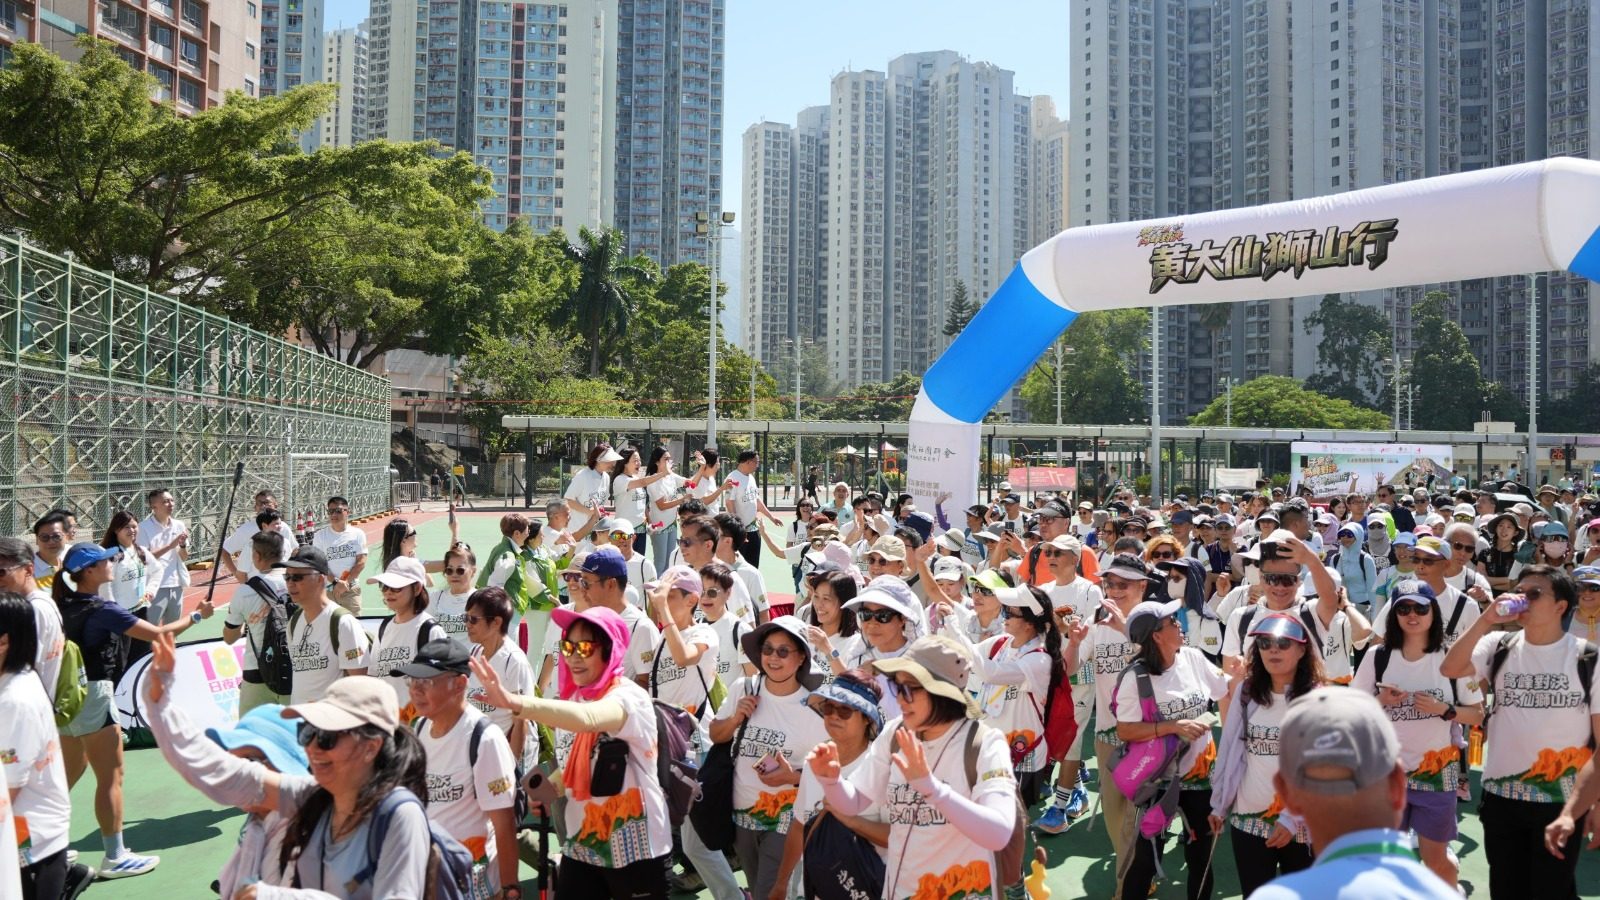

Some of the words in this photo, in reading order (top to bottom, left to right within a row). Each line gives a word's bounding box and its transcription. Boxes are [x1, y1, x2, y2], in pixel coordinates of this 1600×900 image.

[1149, 217, 1400, 294] 黃大仙獅山行
[1503, 672, 1570, 690] 高峰對決
[742, 726, 786, 747] 峰對決
